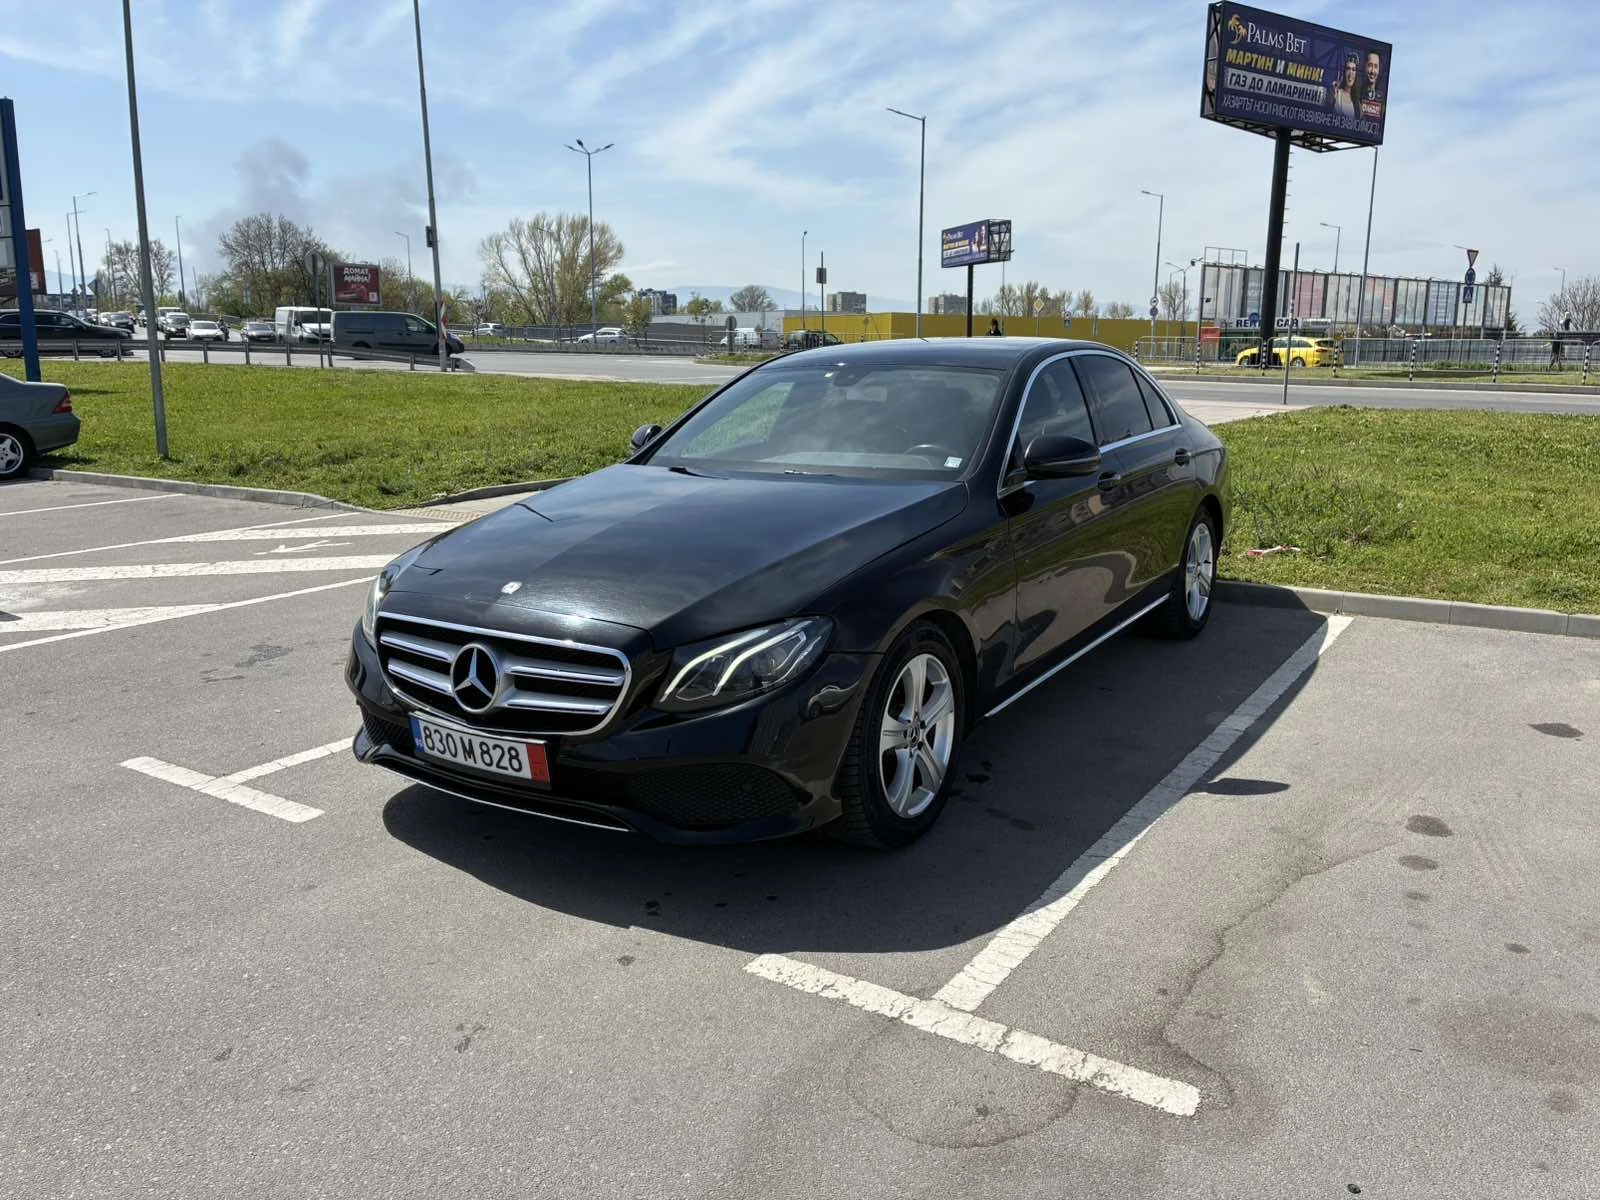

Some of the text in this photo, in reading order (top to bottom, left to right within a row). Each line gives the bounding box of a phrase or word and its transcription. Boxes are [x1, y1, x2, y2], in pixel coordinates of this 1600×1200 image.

[1247, 22, 1307, 54] PALMS BET
[1225, 48, 1325, 83] МАРТИН И МИНИ!
[1228, 72, 1323, 104] ГАЗ ДО ЛАМАРИНИ!
